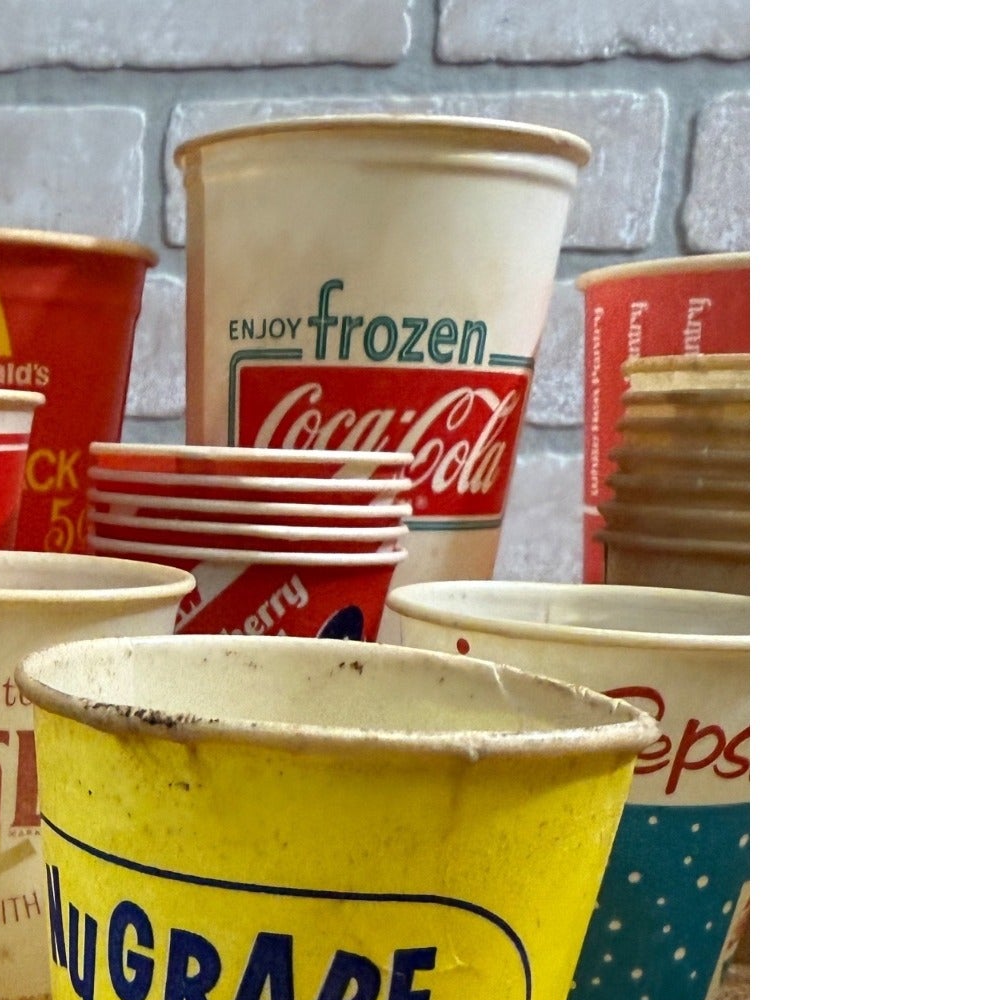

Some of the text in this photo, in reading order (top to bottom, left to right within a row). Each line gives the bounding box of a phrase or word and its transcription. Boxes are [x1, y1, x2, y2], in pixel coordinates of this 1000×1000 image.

[229, 279, 488, 366] ENJOY frozen
[26, 448, 81, 492] CK
[601, 686, 750, 795] eps
